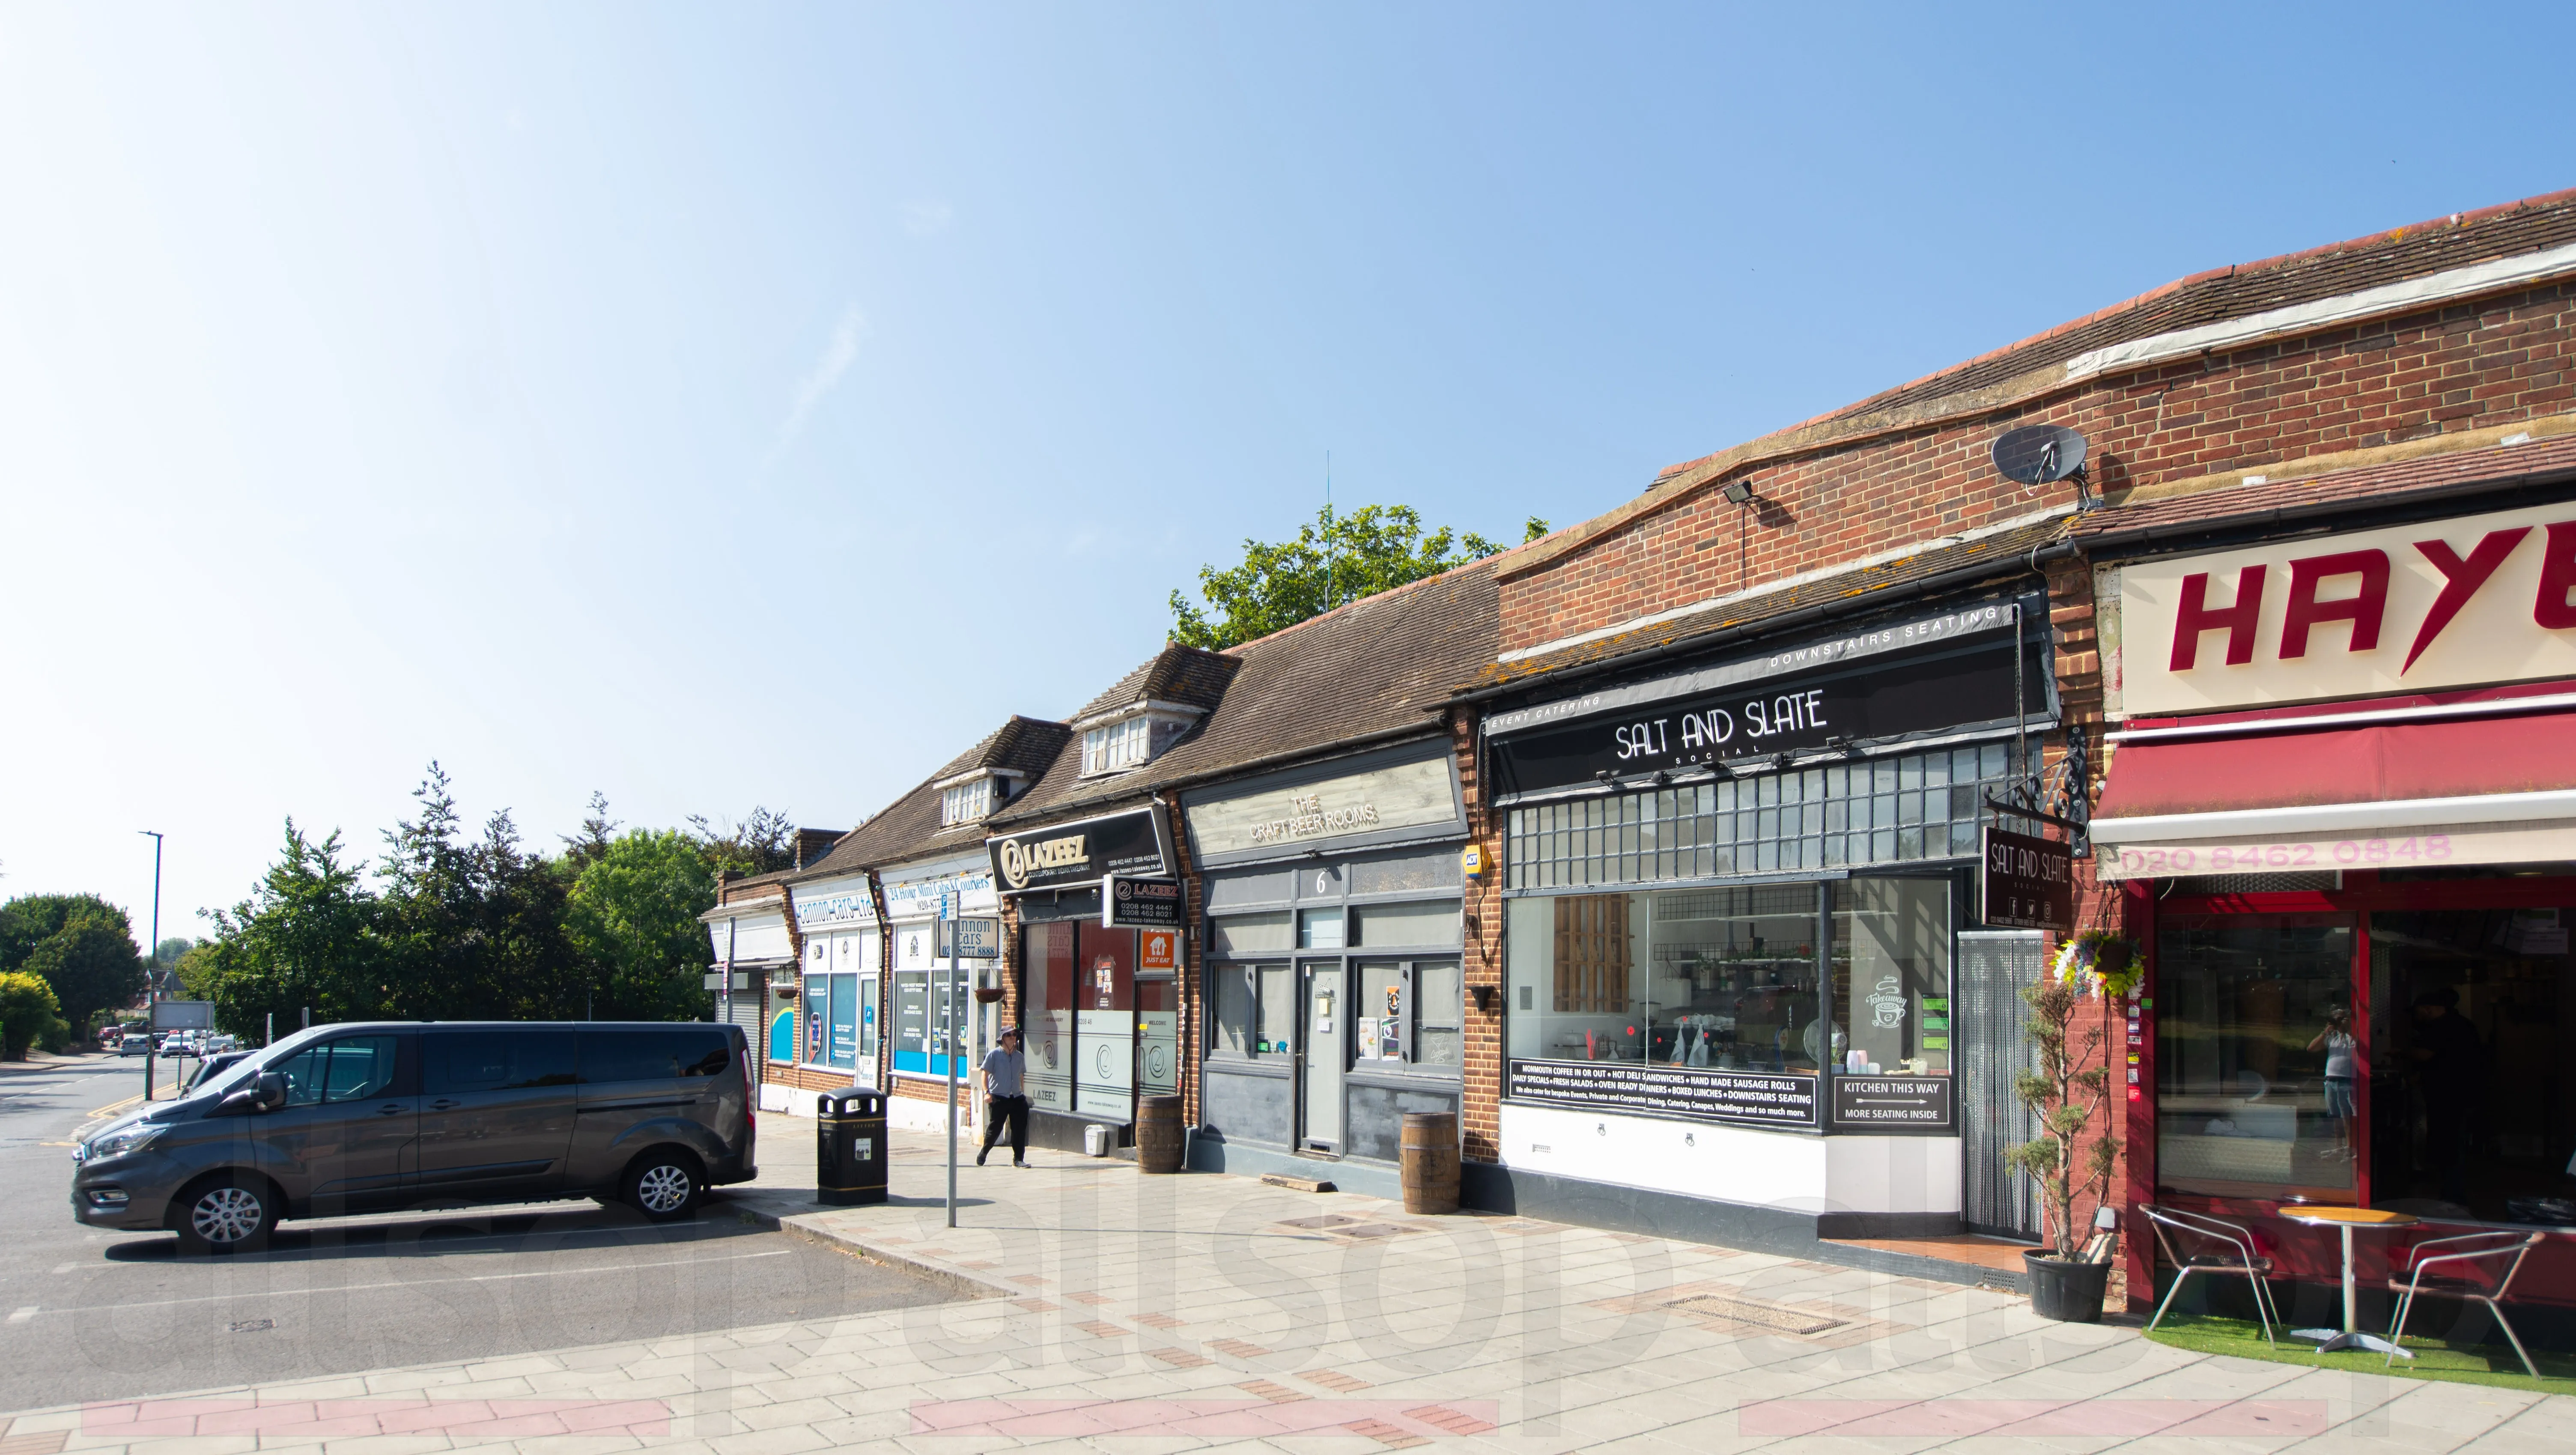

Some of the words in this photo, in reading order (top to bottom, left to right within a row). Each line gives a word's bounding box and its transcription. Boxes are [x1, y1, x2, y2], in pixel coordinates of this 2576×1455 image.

[1771, 632, 1890, 667] DOWNSTAIRS
[1905, 608, 1996, 637] SEATING
[1492, 713, 1529, 728] EVENT
[1536, 697, 1599, 718] CATERING
[1616, 719, 1668, 759] SALT
[1682, 709, 1732, 748] AND
[1745, 689, 1827, 737] SLATE
[1676, 745, 1759, 764] SOCIAL
[1291, 793, 1318, 812] THE
[1249, 820, 1288, 839] CRAFT
[1289, 813, 1323, 833] BEER
[1324, 804, 1374, 827] ROOMS
[1023, 835, 1089, 871] LAZEEZ
[1467, 855, 1477, 865] ADT
[2121, 847, 2195, 872] 020
[2210, 844, 2315, 867] 8462
[2332, 834, 2452, 863] 0848
[1029, 868, 1057, 878] CONTEMPORARY
[1070, 864, 1090, 872] TAKEAWAY
[1110, 863, 1162, 874] www.lazeez-takeaway.co.uk
[1992, 843, 2014, 874] SALT
[2018, 848, 2038, 878] AND
[2042, 852, 2068, 883] SLATE
[890, 888, 898, 901] 24
[899, 886, 916, 900] Hour
[917, 883, 933, 897] Mini
[933, 879, 950, 895] Cabs
[954, 876, 990, 891] Couriers
[1133, 883, 1178, 897] LAZEEZ
[1316, 871, 1325, 893] 6
[2014, 882, 2045, 891] SOCIAL
[856, 894, 874, 917] Ltd
[917, 897, 942, 911] 020-877
[1115, 917, 1178, 925] www.lazeez-takeaway.co.uk
[958, 946, 975, 955] 8777
[978, 946, 995, 955] 8888
[1318, 985, 1330, 993] CLOSED
[1866, 992, 1907, 1008] Takeaway
[1522, 1065, 1552, 1074] MONMOUTH
[1553, 1067, 1573, 1076] COFFEE
[1574, 1068, 1581, 1076] IN
[1583, 1068, 1592, 1077] OR
[1592, 1069, 1606, 1077] OUT
[1612, 1070, 1625, 1079] HOT
[1627, 1071, 1640, 1080] DELI
[1642, 1072, 1685, 1083] SANDWICHES
[1690, 1076, 1709, 1085] HAND
[1711, 1077, 1732, 1087] MADE
[1733, 1079, 1768, 1089] SAUSAGE
[1771, 1081, 1796, 1091] ROLLS
[1844, 1082, 1888, 1093] KITCHEN
[1890, 1083, 1914, 1093] THIS
[1916, 1083, 1939, 1093] WAY
[1033, 1089, 1056, 1102] LAZEEZ
[1527, 1076, 1549, 1084] SPECIALS
[1553, 1078, 1569, 1086] FRESH
[1570, 1079, 1593, 1088] SALADS
[1598, 1081, 1616, 1089] OVEN
[1617, 1082, 1638, 1091] READY
[1639, 1083, 1667, 1094] DINNERS
[1672, 1086, 1693, 1095] BOXED
[1693, 1088, 1723, 1098] LUNCHES
[1728, 1091, 1777, 1102] DOWNSTAIRS
[1778, 1094, 1811, 1104] SEATING
[1551, 1089, 1570, 1098] bespoke
[1570, 1091, 1589, 1099] Events,
[1589, 1092, 1608, 1100] Private
[1620, 1094, 1646, 1103] Corporate
[1647, 1097, 1666, 1107] Dining,
[1667, 1099, 1690, 1109] Catering,
[1691, 1101, 1714, 1111] Canapes,
[1715, 1103, 1744, 1113] Weddings
[1768, 1107, 1785, 1115] much
[1845, 1109, 1870, 1118] MORE
[1872, 1109, 1908, 1118] SEATING
[1910, 1110, 1938, 1119] INSIDE
